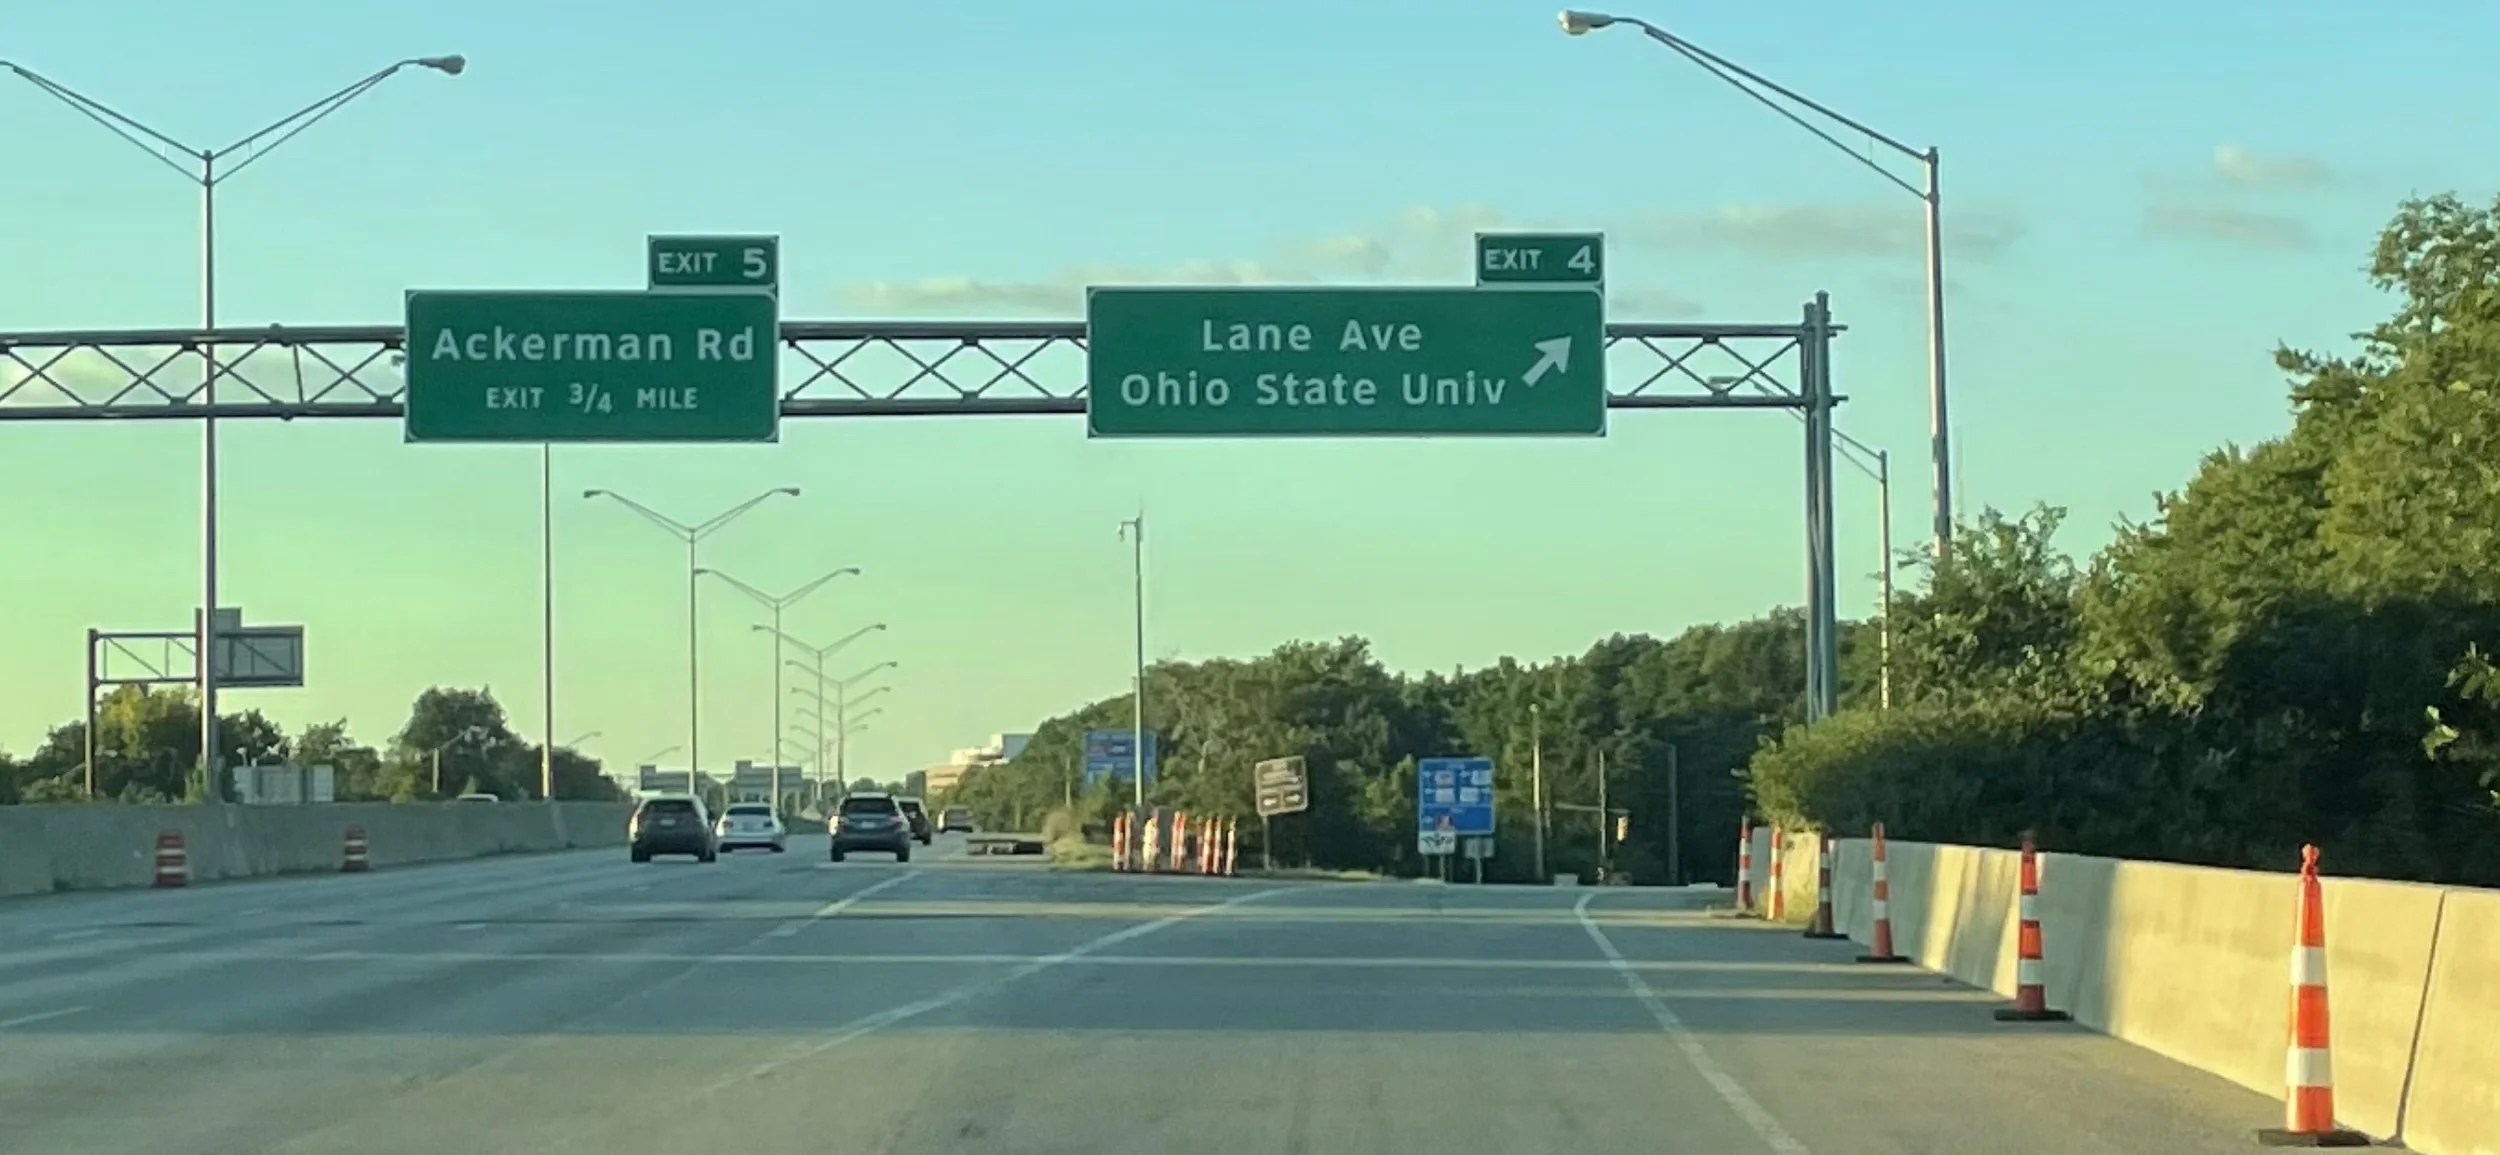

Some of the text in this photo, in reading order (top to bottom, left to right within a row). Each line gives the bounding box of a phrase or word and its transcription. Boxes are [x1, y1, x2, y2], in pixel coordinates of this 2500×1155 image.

[658, 248, 767, 278] EXIT 5
[1484, 245, 1596, 274] EXIT 4
[432, 325, 754, 361] Ackerman Rd
[1202, 319, 1423, 351] Lane Ave
[486, 388, 544, 409] EXIT
[637, 388, 699, 409] MILE
[1121, 370, 1507, 407] Ohio State Univ
